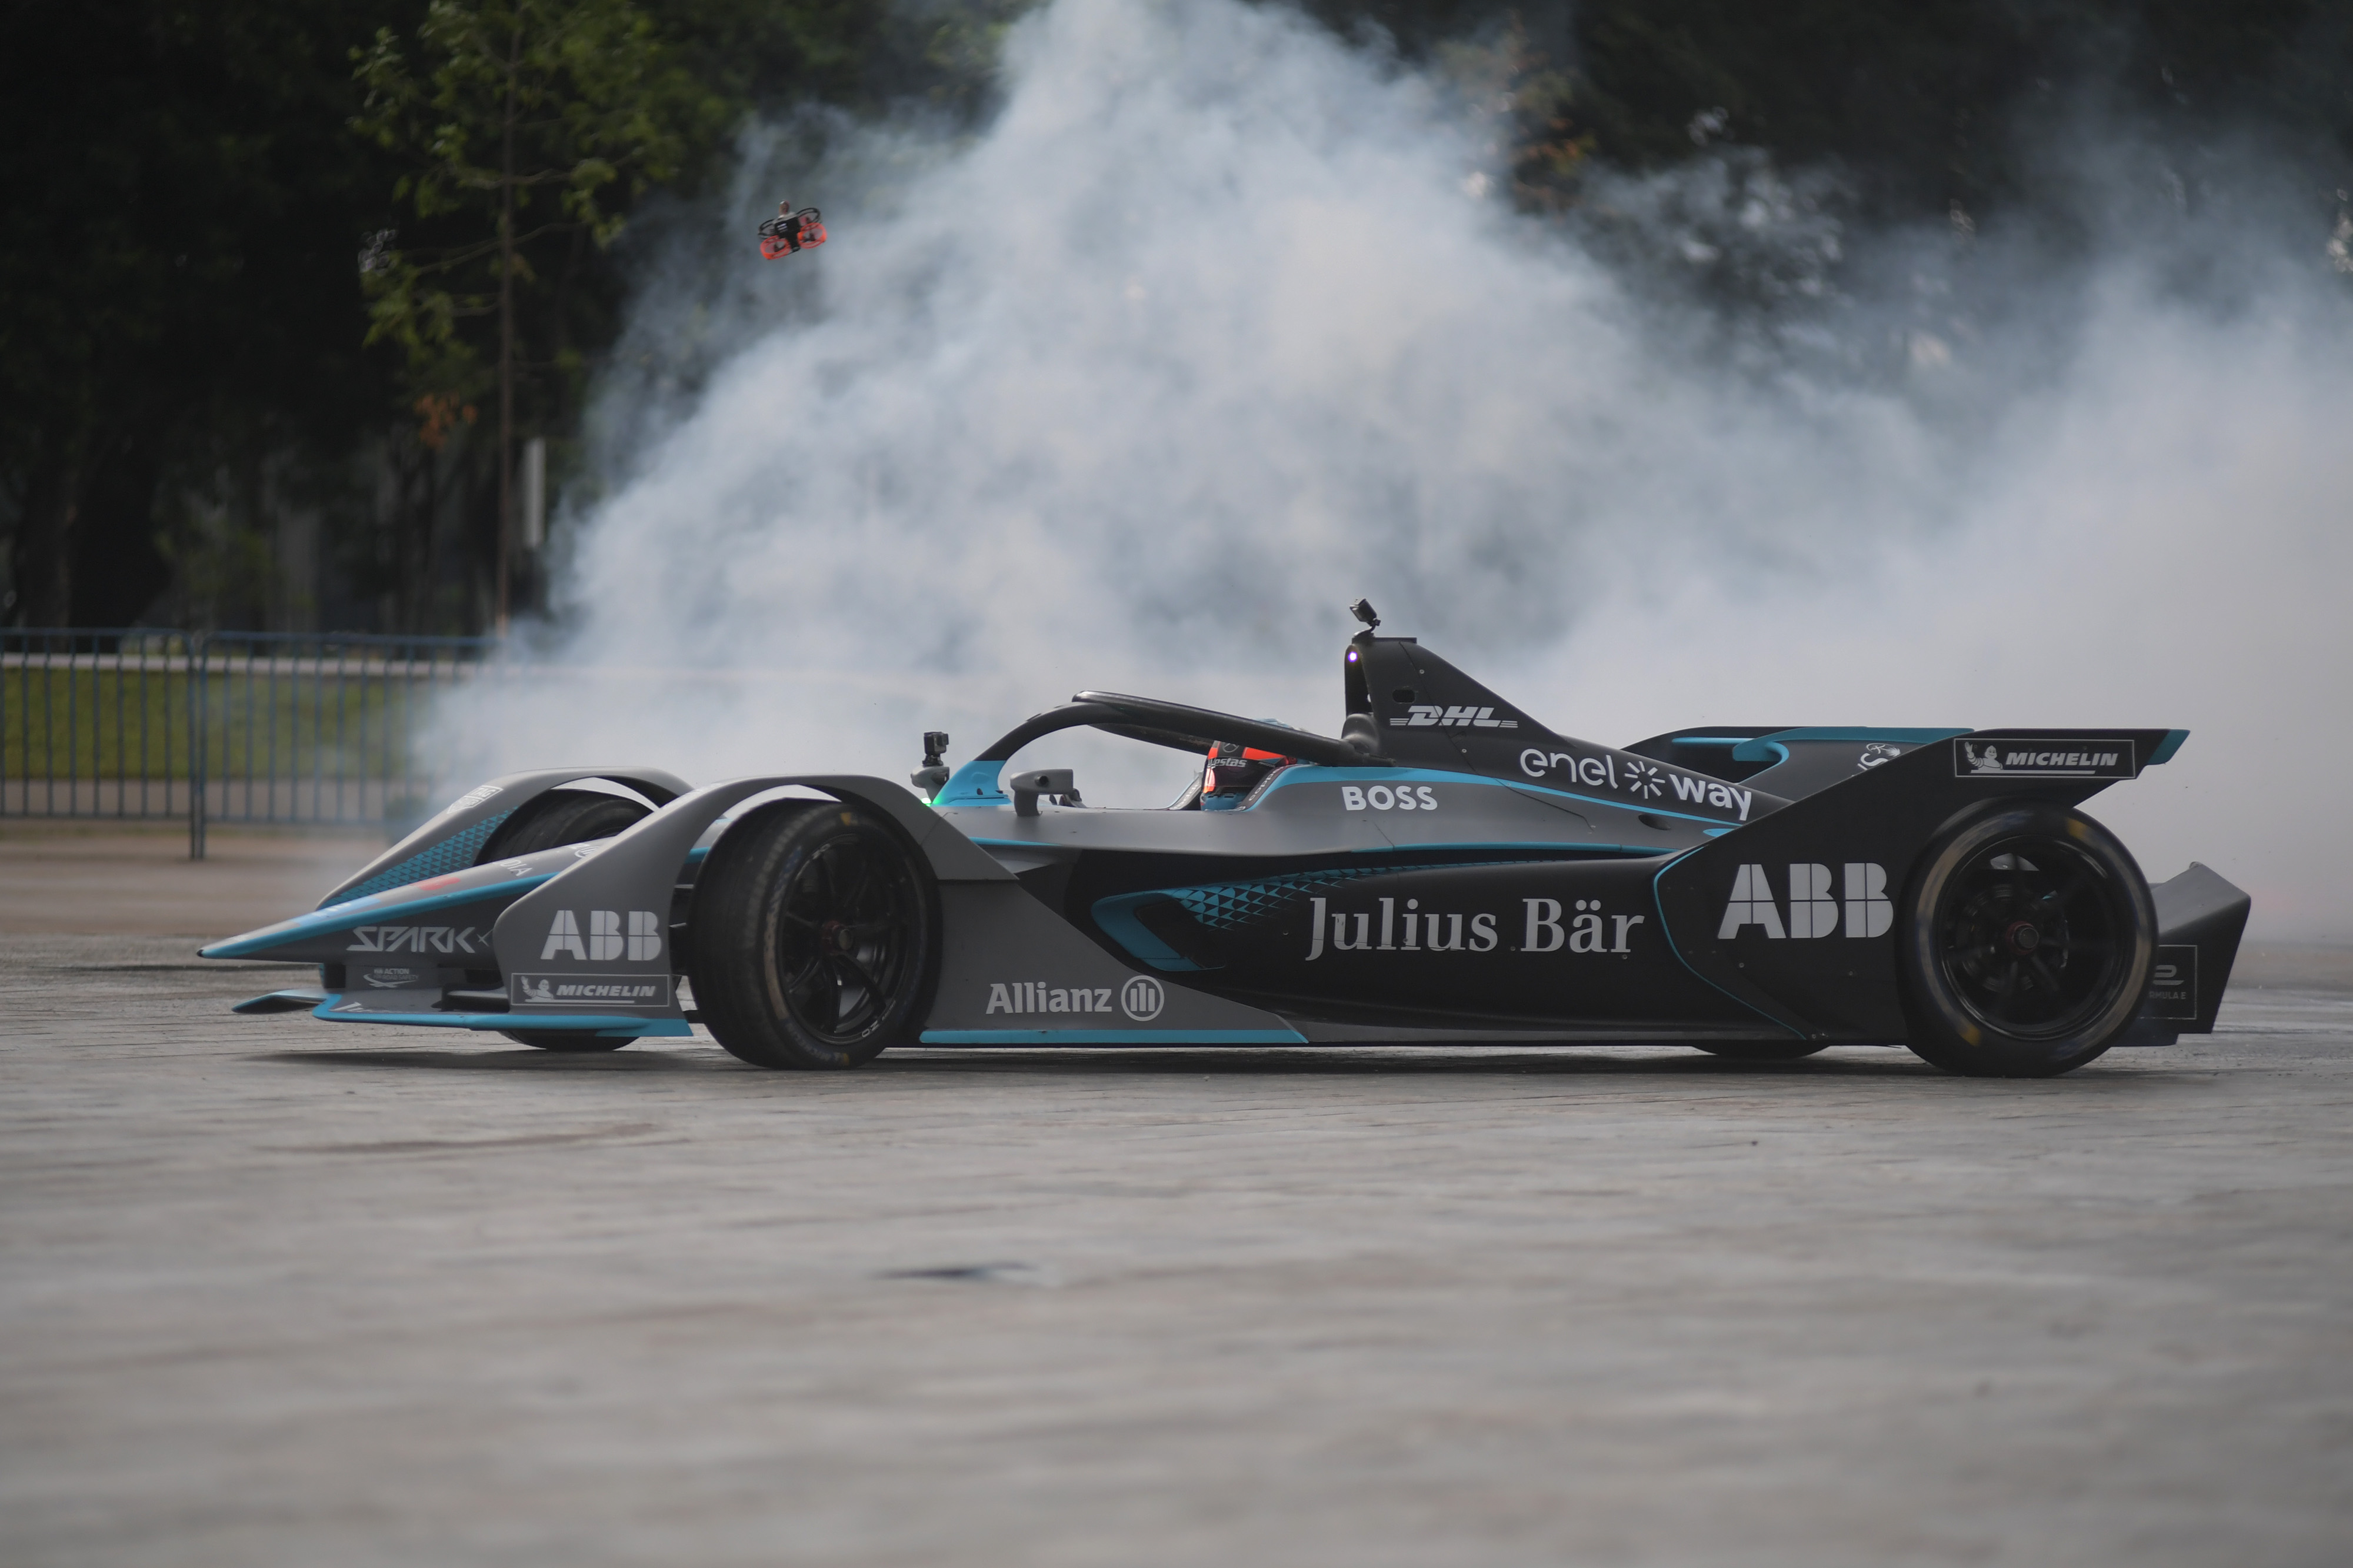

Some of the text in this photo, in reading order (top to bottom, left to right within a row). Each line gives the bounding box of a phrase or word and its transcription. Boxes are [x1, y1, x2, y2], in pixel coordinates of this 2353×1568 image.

[1408, 705, 1501, 728] DHL
[2005, 752, 2118, 766] MICHELIN
[1341, 785, 1438, 810] BOSS
[1520, 749, 1752, 821] enel way
[1718, 863, 1894, 939] ABB
[346, 926, 475, 953] SPARK
[540, 910, 662, 960] ABB
[1305, 898, 1645, 960] Julius Bär
[556, 985, 656, 997] MICHELIN
[985, 982, 1112, 1014] Allianz
[2149, 991, 2179, 999] RMULA
